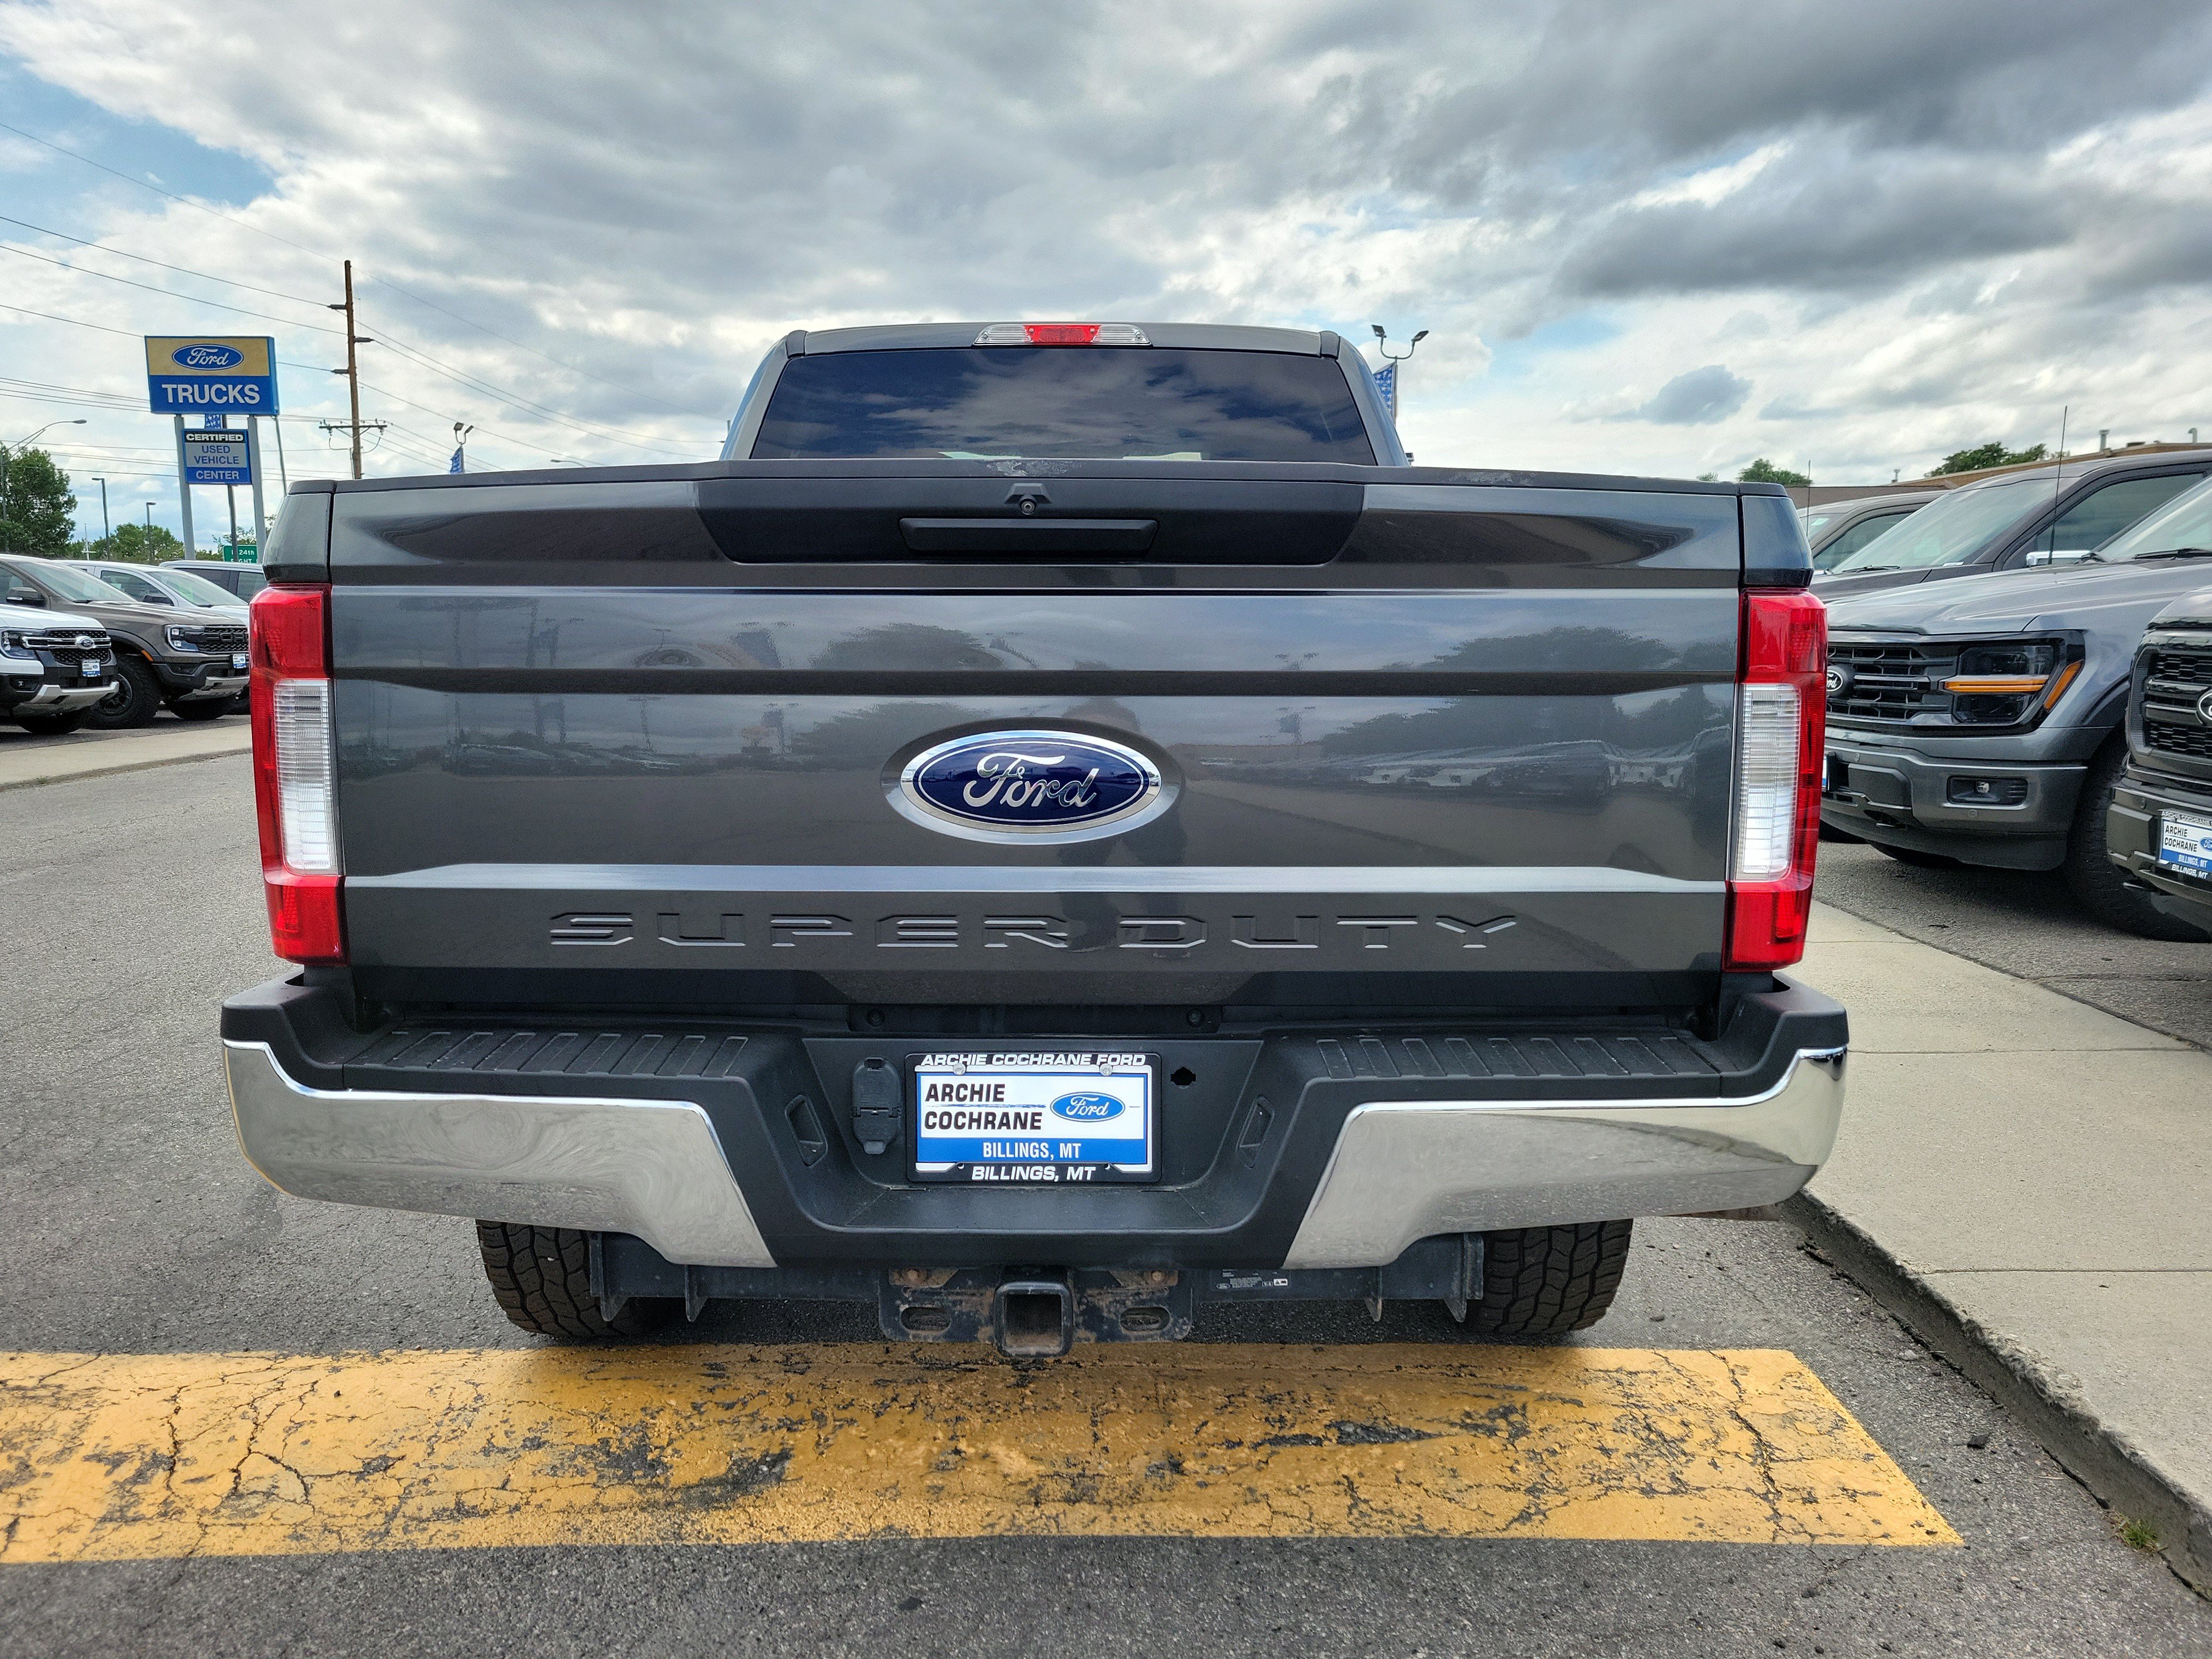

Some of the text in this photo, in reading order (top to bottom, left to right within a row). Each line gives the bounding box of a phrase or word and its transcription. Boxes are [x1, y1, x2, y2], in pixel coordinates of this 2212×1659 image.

[186, 347, 230, 366] Ford
[162, 383, 261, 404] TRUCKS
[185, 433, 244, 442] CERTIFIED
[201, 445, 230, 454] USED
[194, 455, 239, 465] VEHICLE
[195, 470, 240, 480] CENTER
[963, 752, 1100, 808] Ford
[2165, 825, 2188, 838] ARCHIE
[2164, 837, 2198, 853] COCHRANE
[2178, 854, 2209, 868] BILLINGS, MT
[2171, 864, 2209, 879] BILLINGS, MT
[550, 912, 1516, 949] SUPER DUTY
[921, 1053, 1147, 1066] ARCHIE COCHRANE FORD
[924, 1083, 1006, 1102] ARCHIE
[1065, 1096, 1110, 1116] Ford
[924, 1111, 1043, 1130] COCHRANE
[982, 1141, 1082, 1161] BILLINGS, MT
[971, 1165, 1097, 1182] BILLINGS, MT
